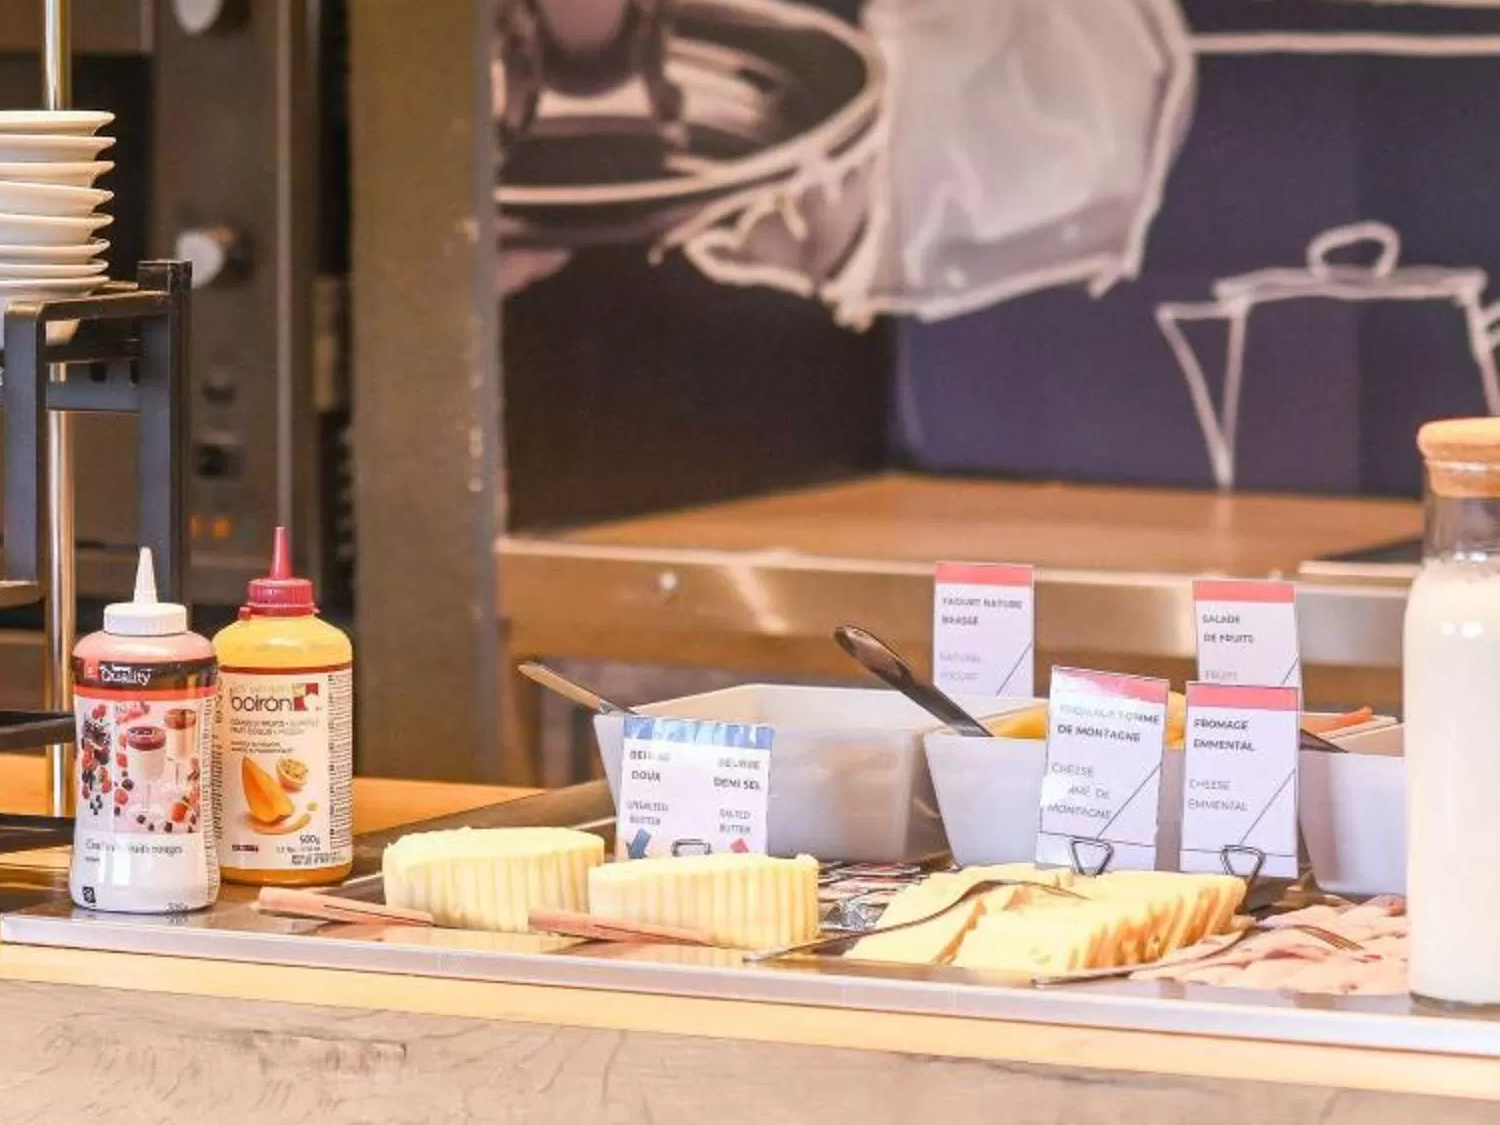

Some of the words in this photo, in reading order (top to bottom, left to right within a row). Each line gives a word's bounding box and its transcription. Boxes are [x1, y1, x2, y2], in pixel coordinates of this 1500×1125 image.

[1202, 614, 1241, 624] SALADE
[1203, 633, 1217, 643] DE
[1219, 634, 1255, 644] FRUITS
[230, 687, 292, 712] boiron
[1193, 718, 1249, 730] FROMAGE
[1057, 724, 1073, 734] DE
[1075, 726, 1141, 742] MONTAGNE
[1193, 738, 1257, 752] EMMENTAL
[713, 776, 741, 789] DEMI
[1187, 798, 1249, 811] EMMENTAL
